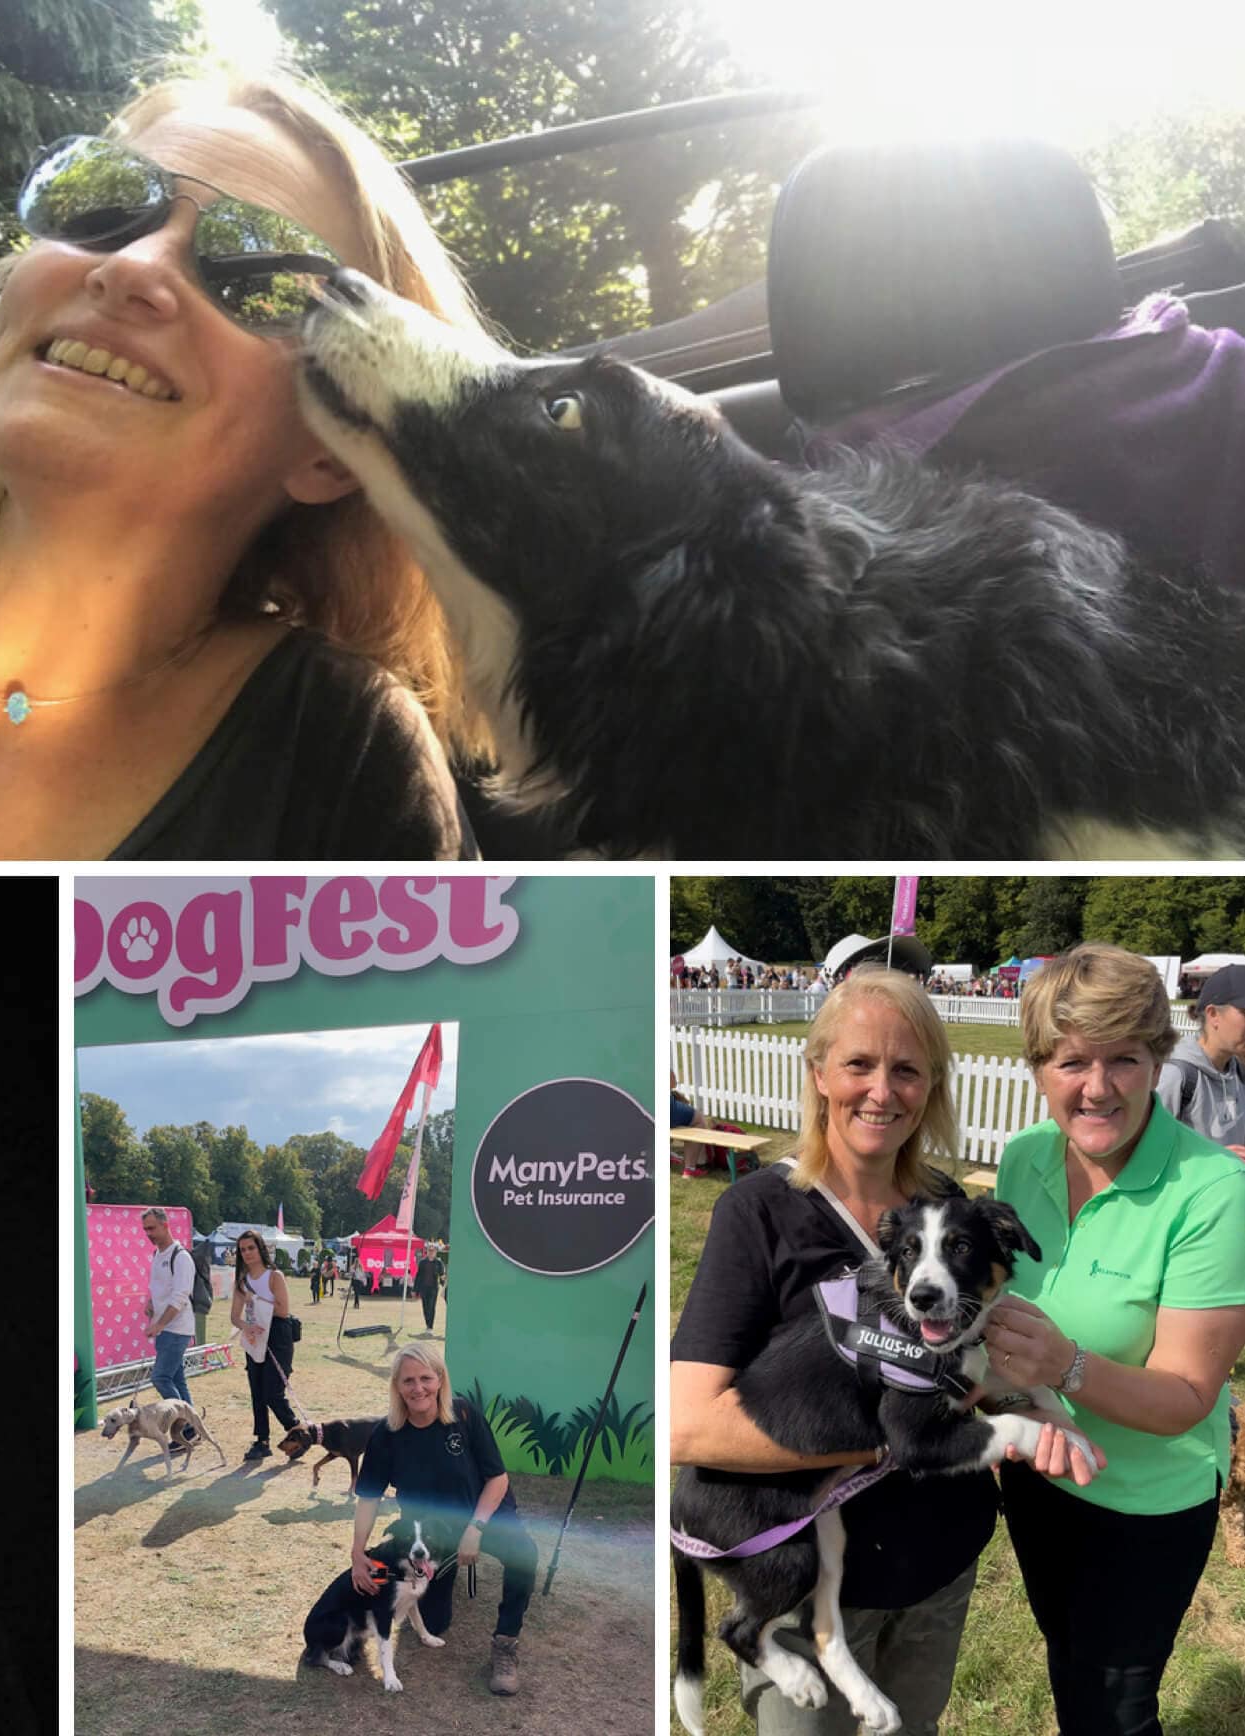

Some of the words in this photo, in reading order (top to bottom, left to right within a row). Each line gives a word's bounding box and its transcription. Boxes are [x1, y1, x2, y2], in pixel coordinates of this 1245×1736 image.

[488, 1152, 646, 1187] ManyPets
[503, 1189, 534, 1206] Pet
[538, 1188, 626, 1206] Insurance
[856, 1329, 926, 1359] JULIUS-K9
